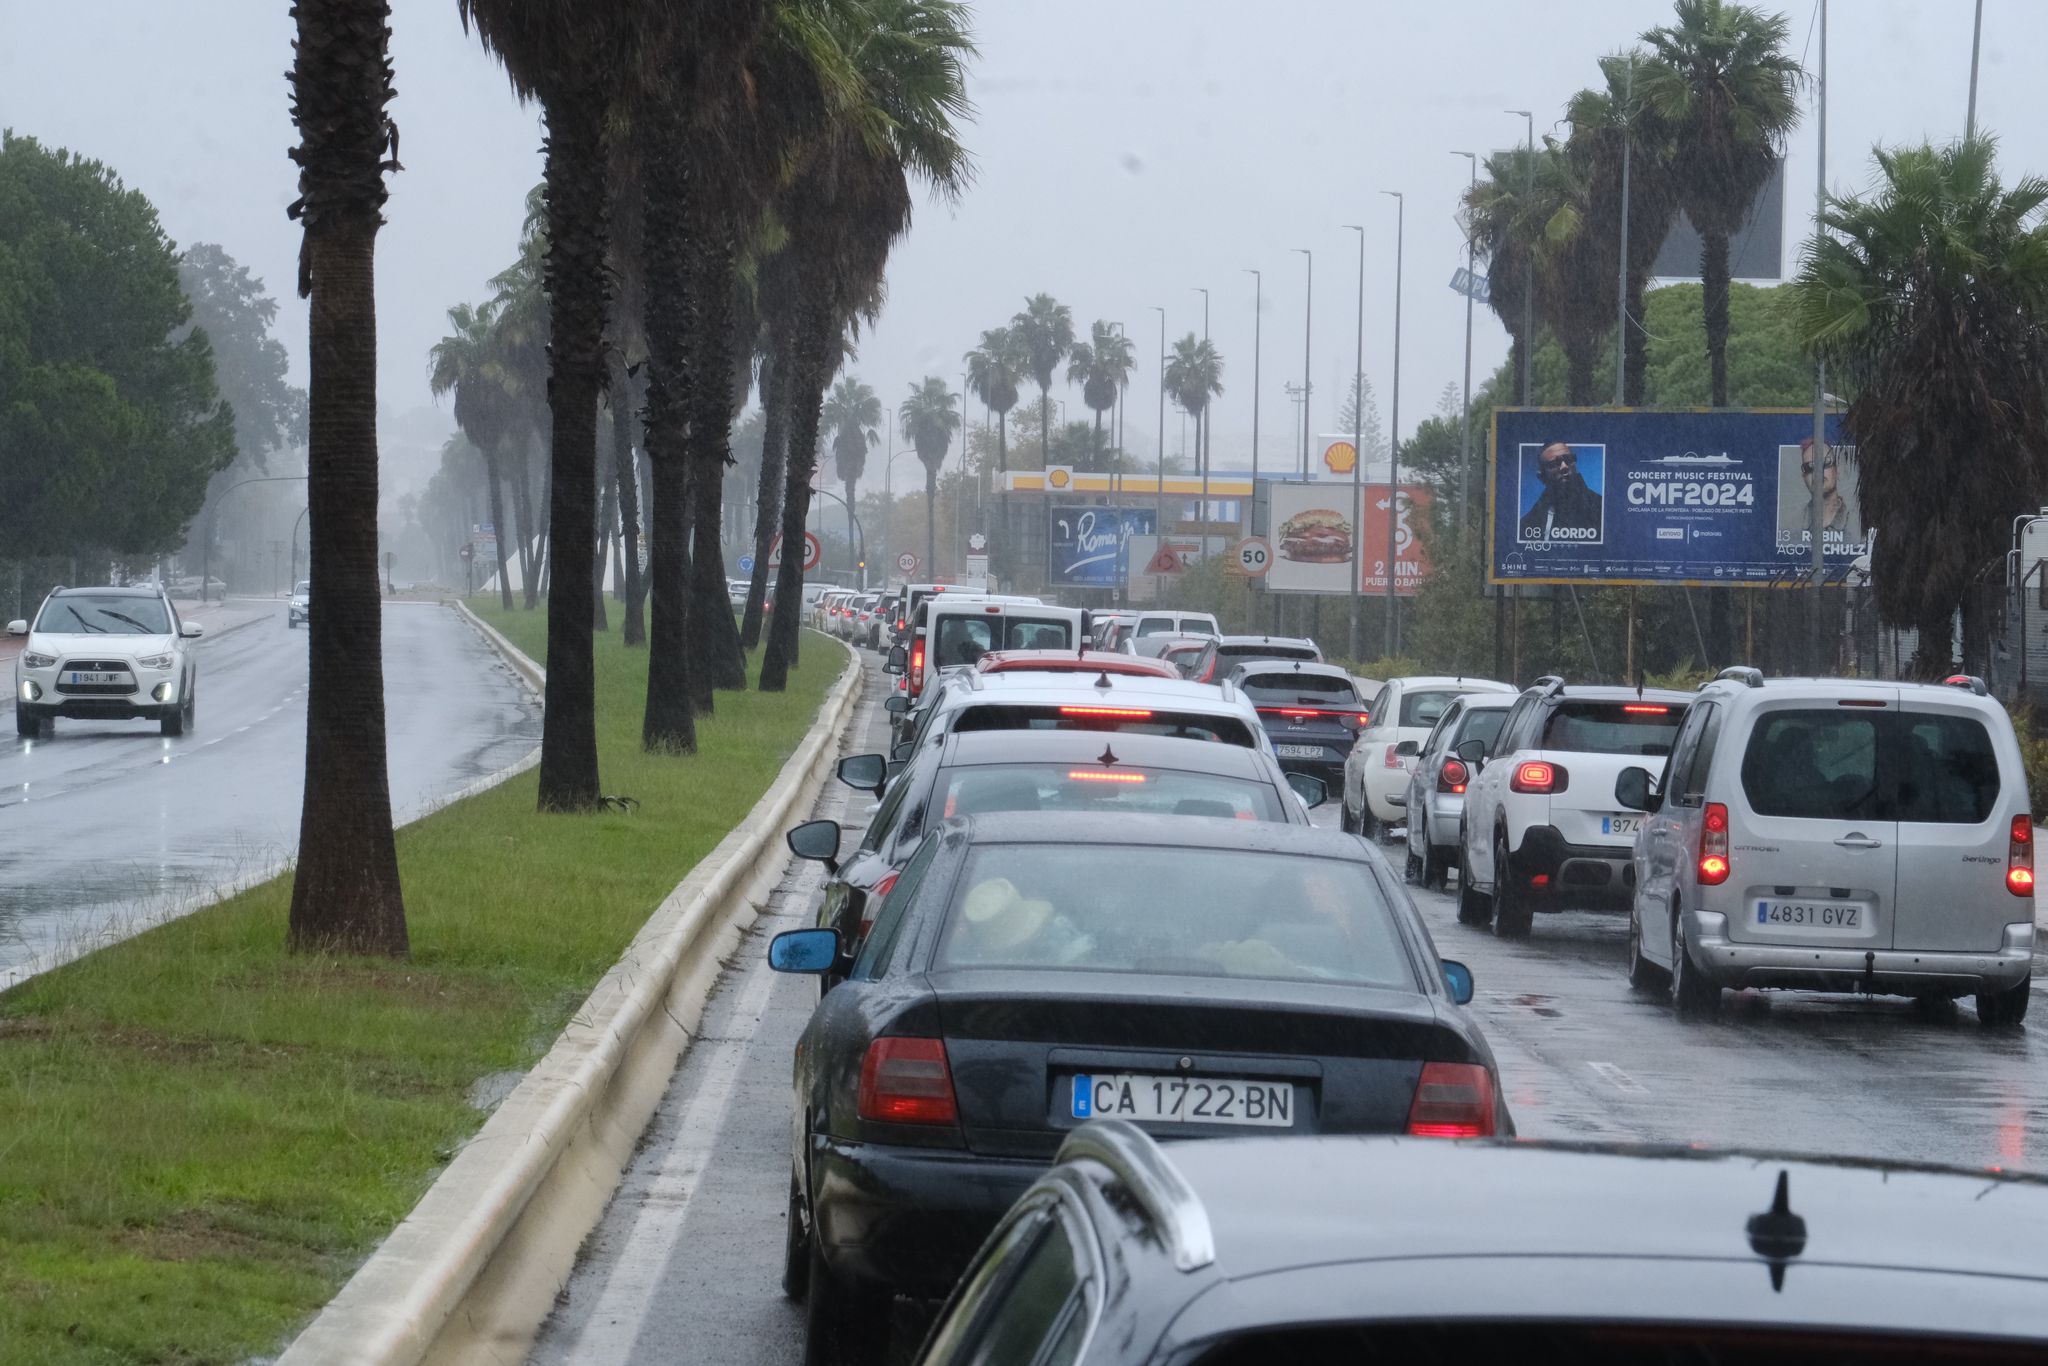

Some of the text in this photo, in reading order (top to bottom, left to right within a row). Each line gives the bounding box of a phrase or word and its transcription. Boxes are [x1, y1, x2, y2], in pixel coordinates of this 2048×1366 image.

[1627, 471, 1753, 481] CONCERT MUSIC FESTIVAL
[1627, 481, 1754, 506] CMF2024
[1525, 527, 1597, 539] 08 GORDO
[1659, 529, 1682, 537] Lenovo
[1777, 529, 1844, 542] 13 RBIN
[1525, 540, 1552, 551] AGO
[1777, 543, 1805, 555] AGO
[901, 558, 913, 566] 30
[1242, 550, 1265, 564] 50
[1374, 560, 1384, 575] 2
[1501, 563, 1527, 571] SHINE
[1365, 577, 1402, 587] PUERO
[1280, 745, 1301, 755] 7594
[1770, 905, 1857, 926] 4831 GVZ
[1093, 1080, 1136, 1114] CA
[1078, 1100, 1087, 1110] E
